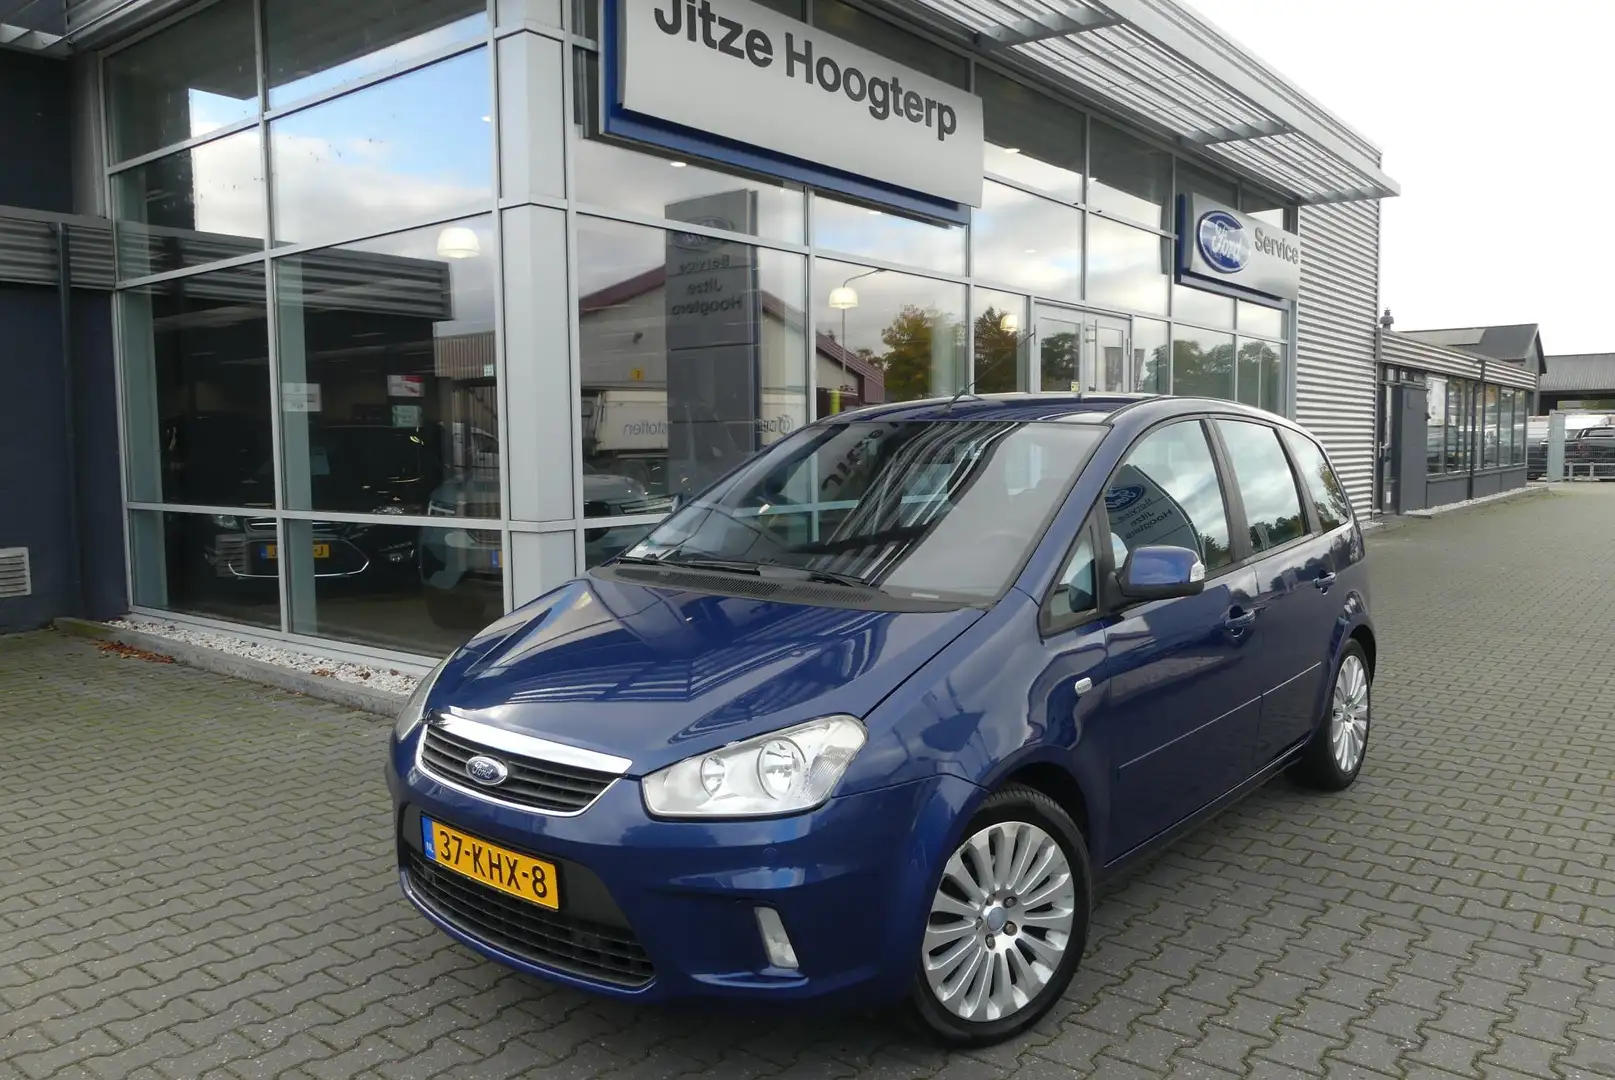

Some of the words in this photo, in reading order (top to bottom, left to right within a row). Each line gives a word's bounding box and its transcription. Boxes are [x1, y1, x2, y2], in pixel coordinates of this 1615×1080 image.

[654, 0, 774, 68] Jitze
[785, 32, 957, 141] Hoogterp
[1211, 219, 1244, 264] Ford
[1254, 226, 1299, 266] Service
[470, 761, 493, 780] Ford
[439, 830, 548, 898] 37-KHX-8
